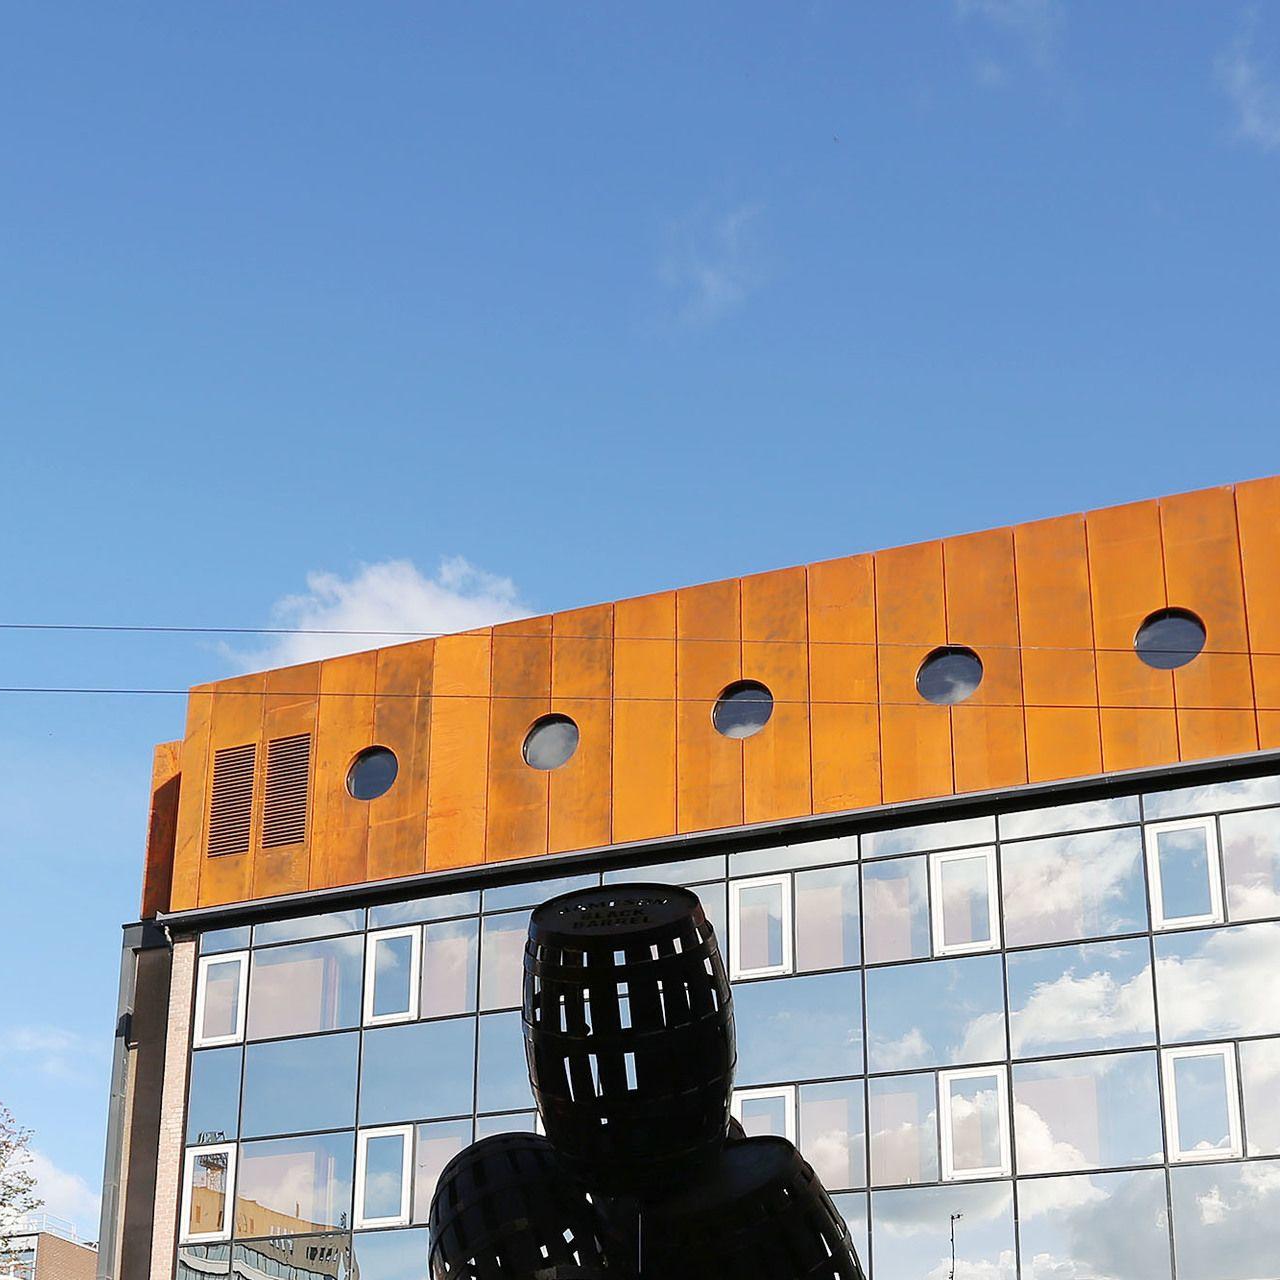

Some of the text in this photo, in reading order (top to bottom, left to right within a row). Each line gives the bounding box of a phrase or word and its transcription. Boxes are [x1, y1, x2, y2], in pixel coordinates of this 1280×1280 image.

[558, 896, 671, 917] JAMESON
[572, 915, 650, 930] BARREL
[581, 909, 645, 921] BLACK
